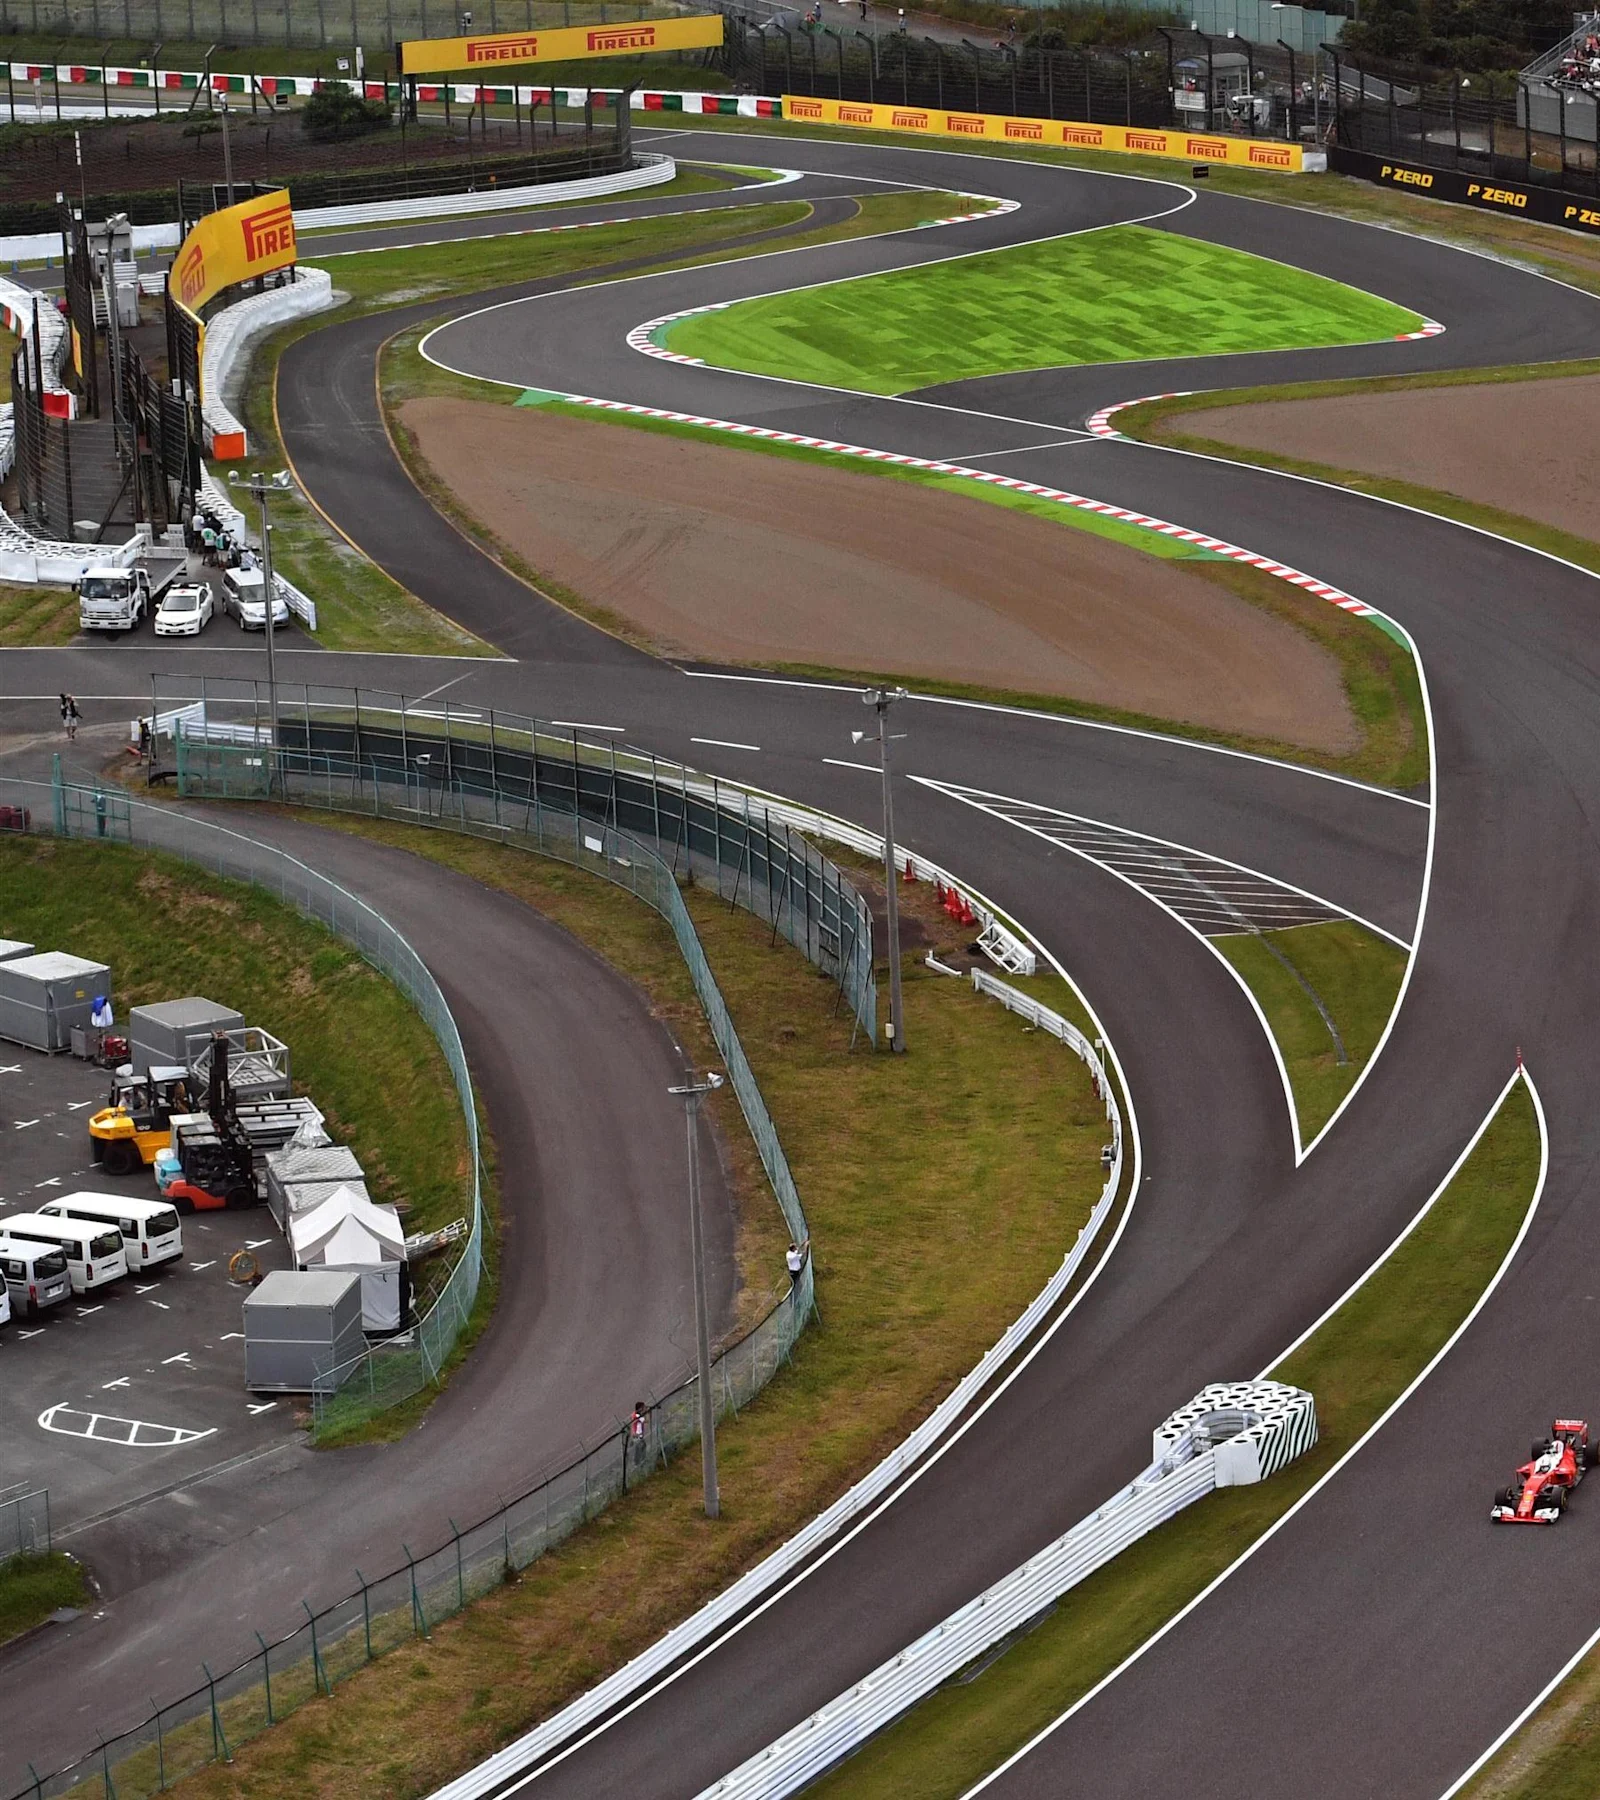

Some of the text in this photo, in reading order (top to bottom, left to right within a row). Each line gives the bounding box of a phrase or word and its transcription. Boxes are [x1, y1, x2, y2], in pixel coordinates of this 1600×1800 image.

[586, 27, 655, 51] PIRELLI
[466, 37, 537, 62] PIRELLI
[790, 101, 822, 118] PIRELLI
[838, 105, 873, 123] PIRELLI
[891, 111, 928, 129] PIRELLI
[947, 116, 985, 134] PIRELLI
[1005, 122, 1043, 139] PIRELLI
[1063, 127, 1103, 145] PIRELLI
[1125, 132, 1167, 151] PIRELLI
[1187, 139, 1227, 159] PIRELLI
[1249, 146, 1291, 166] PIRELLI
[1381, 166, 1434, 188] P ZERO
[1467, 184, 1527, 208] P ZERO
[1565, 206, 1577, 219] P
